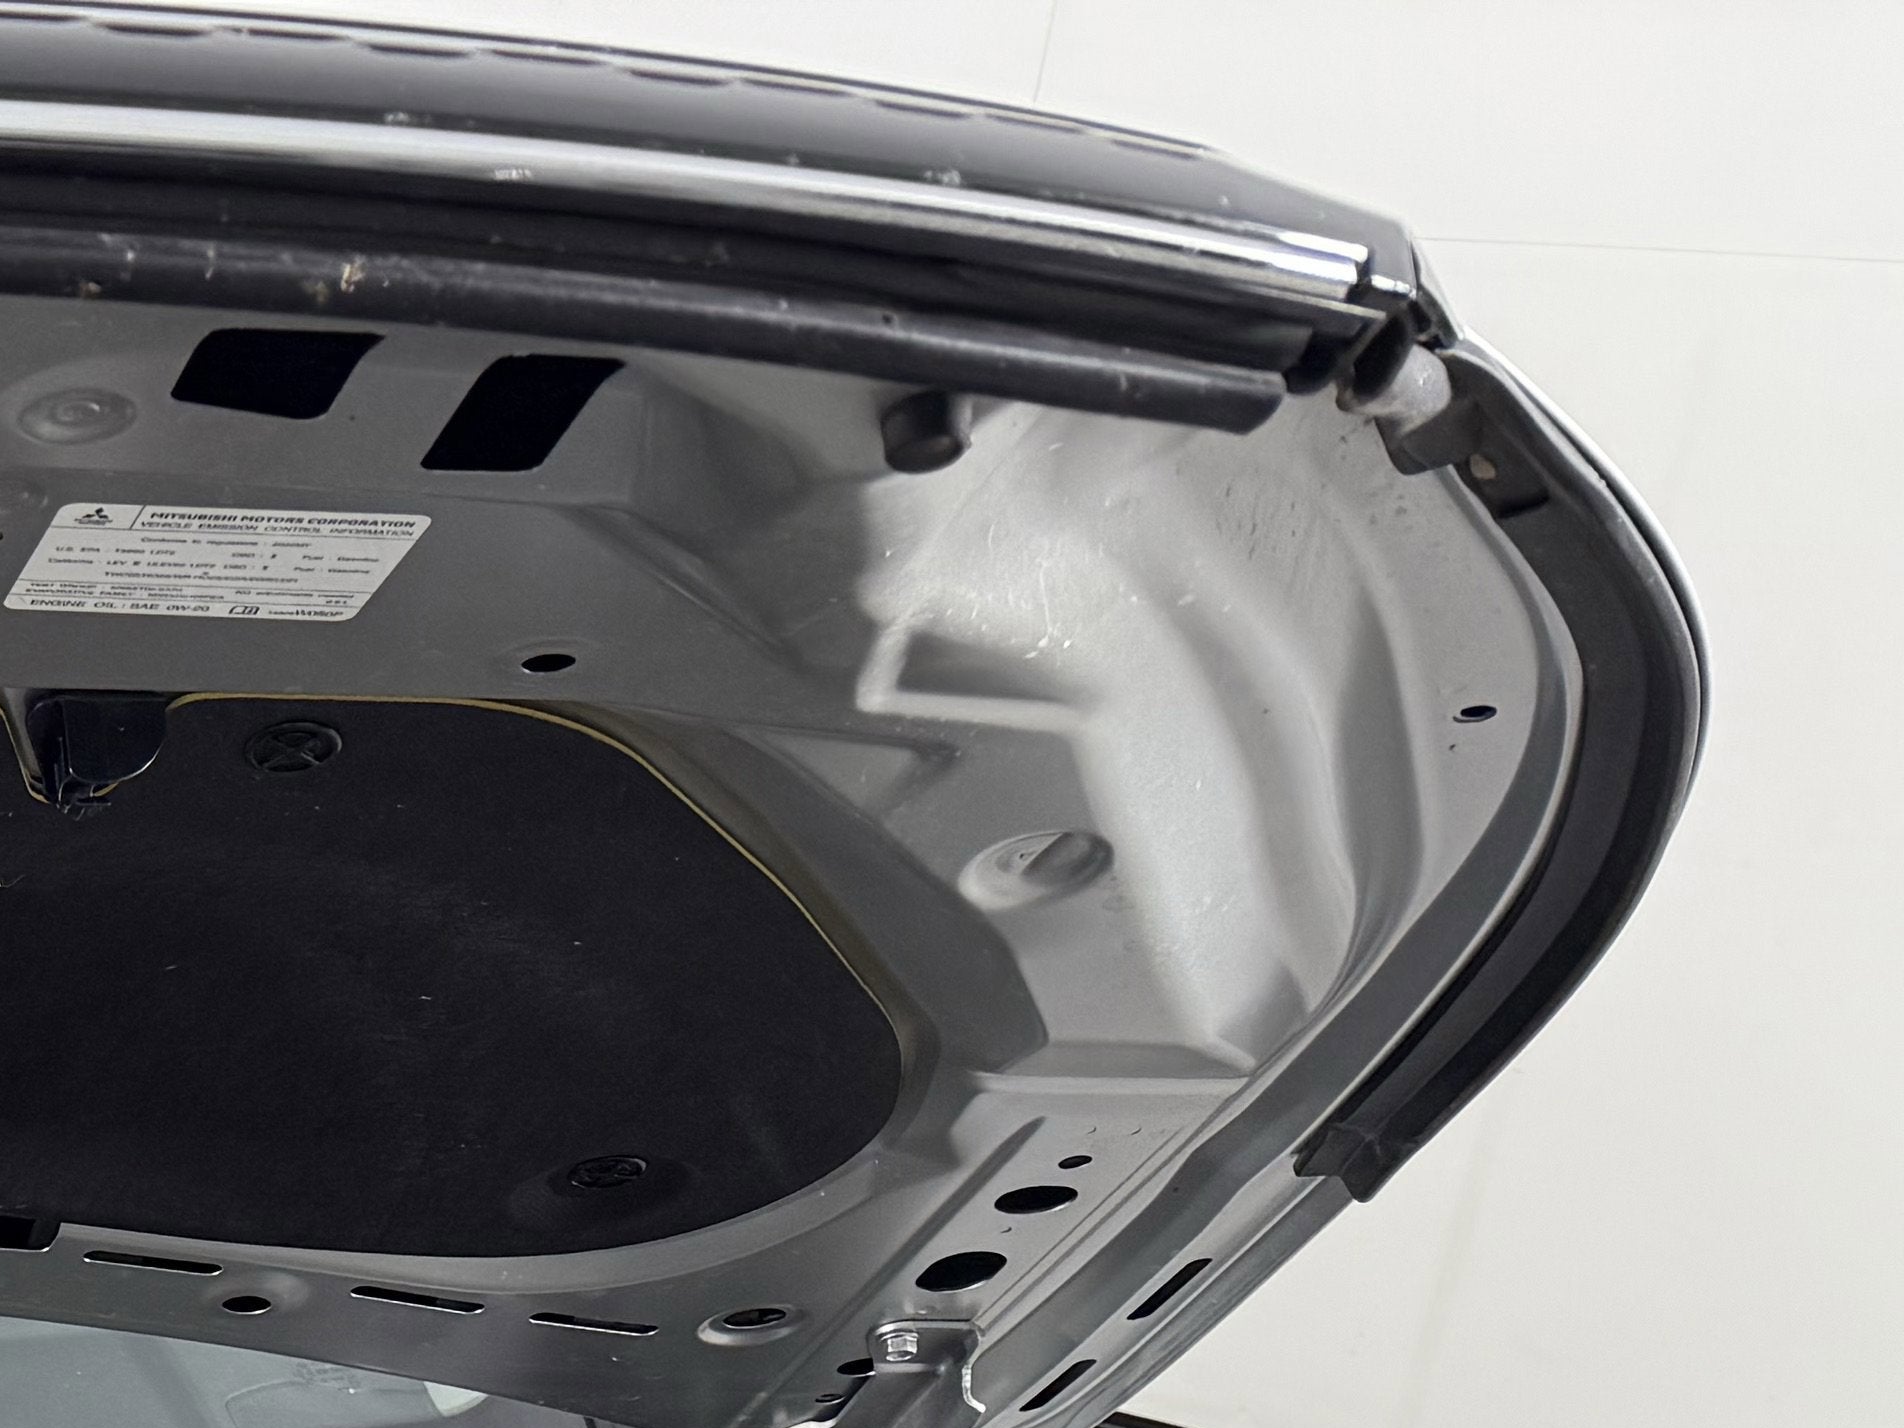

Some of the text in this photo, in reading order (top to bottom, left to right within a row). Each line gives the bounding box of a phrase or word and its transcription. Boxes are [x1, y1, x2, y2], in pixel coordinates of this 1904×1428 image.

[150, 512, 416, 528] MITSUBISHI MOTORS CORPORATION
[141, 521, 193, 529] VEHICLE
[264, 526, 322, 534] CONTROL
[329, 528, 414, 537] INFORMATION
